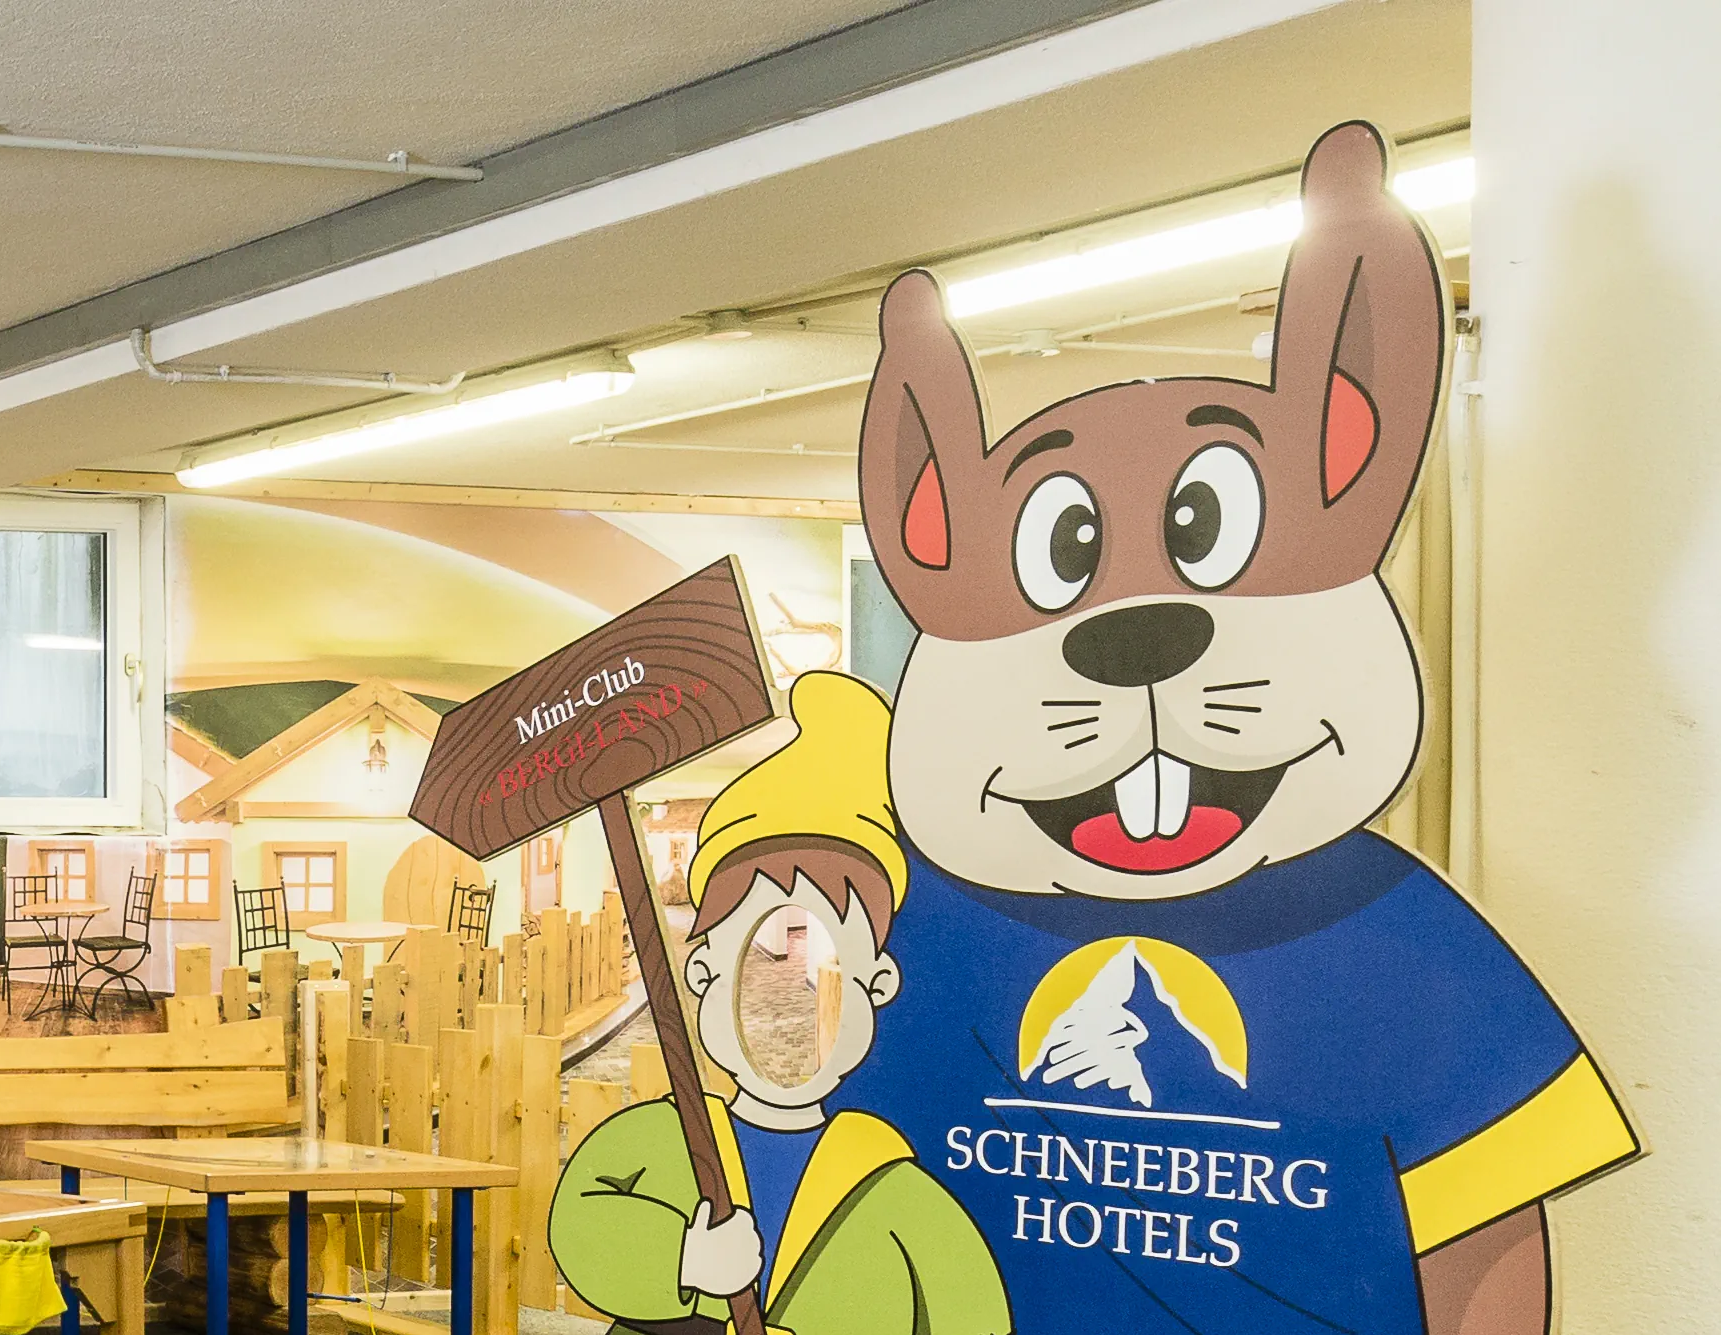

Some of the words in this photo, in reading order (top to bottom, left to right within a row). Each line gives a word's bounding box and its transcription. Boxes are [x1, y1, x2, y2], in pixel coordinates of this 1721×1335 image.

[513, 656, 645, 745] Mini-Club
[946, 1126, 1329, 1209] SCHNEEBERG
[1012, 1195, 1241, 1267] HOTELS
